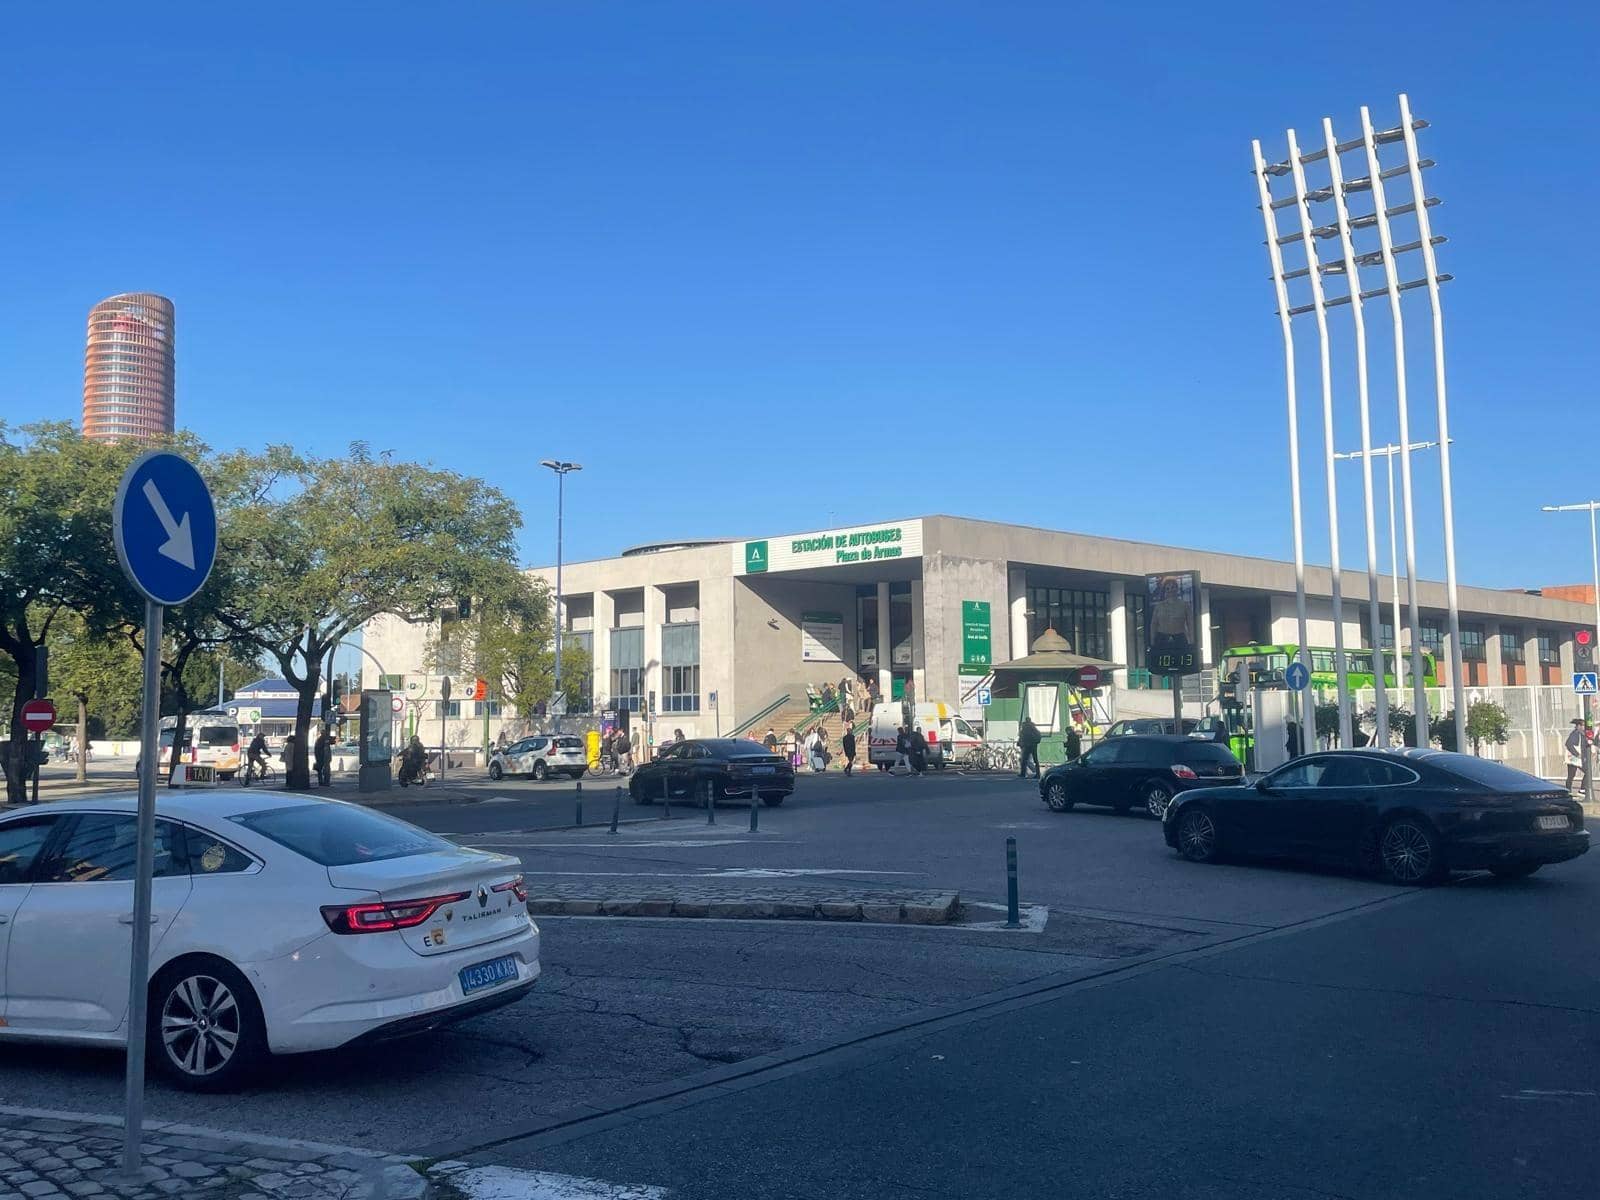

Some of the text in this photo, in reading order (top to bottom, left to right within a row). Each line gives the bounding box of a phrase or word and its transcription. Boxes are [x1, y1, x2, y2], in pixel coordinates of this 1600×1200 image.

[792, 528, 902, 553] ESTACIÓN DE AUTOBUSES
[836, 545, 903, 563] Plaza de Armas
[1159, 654, 1193, 667] 10:13
[980, 690, 989, 704] P
[229, 708, 237, 716] P
[192, 766, 213, 782] TAXI
[462, 908, 501, 922] TALISMAN
